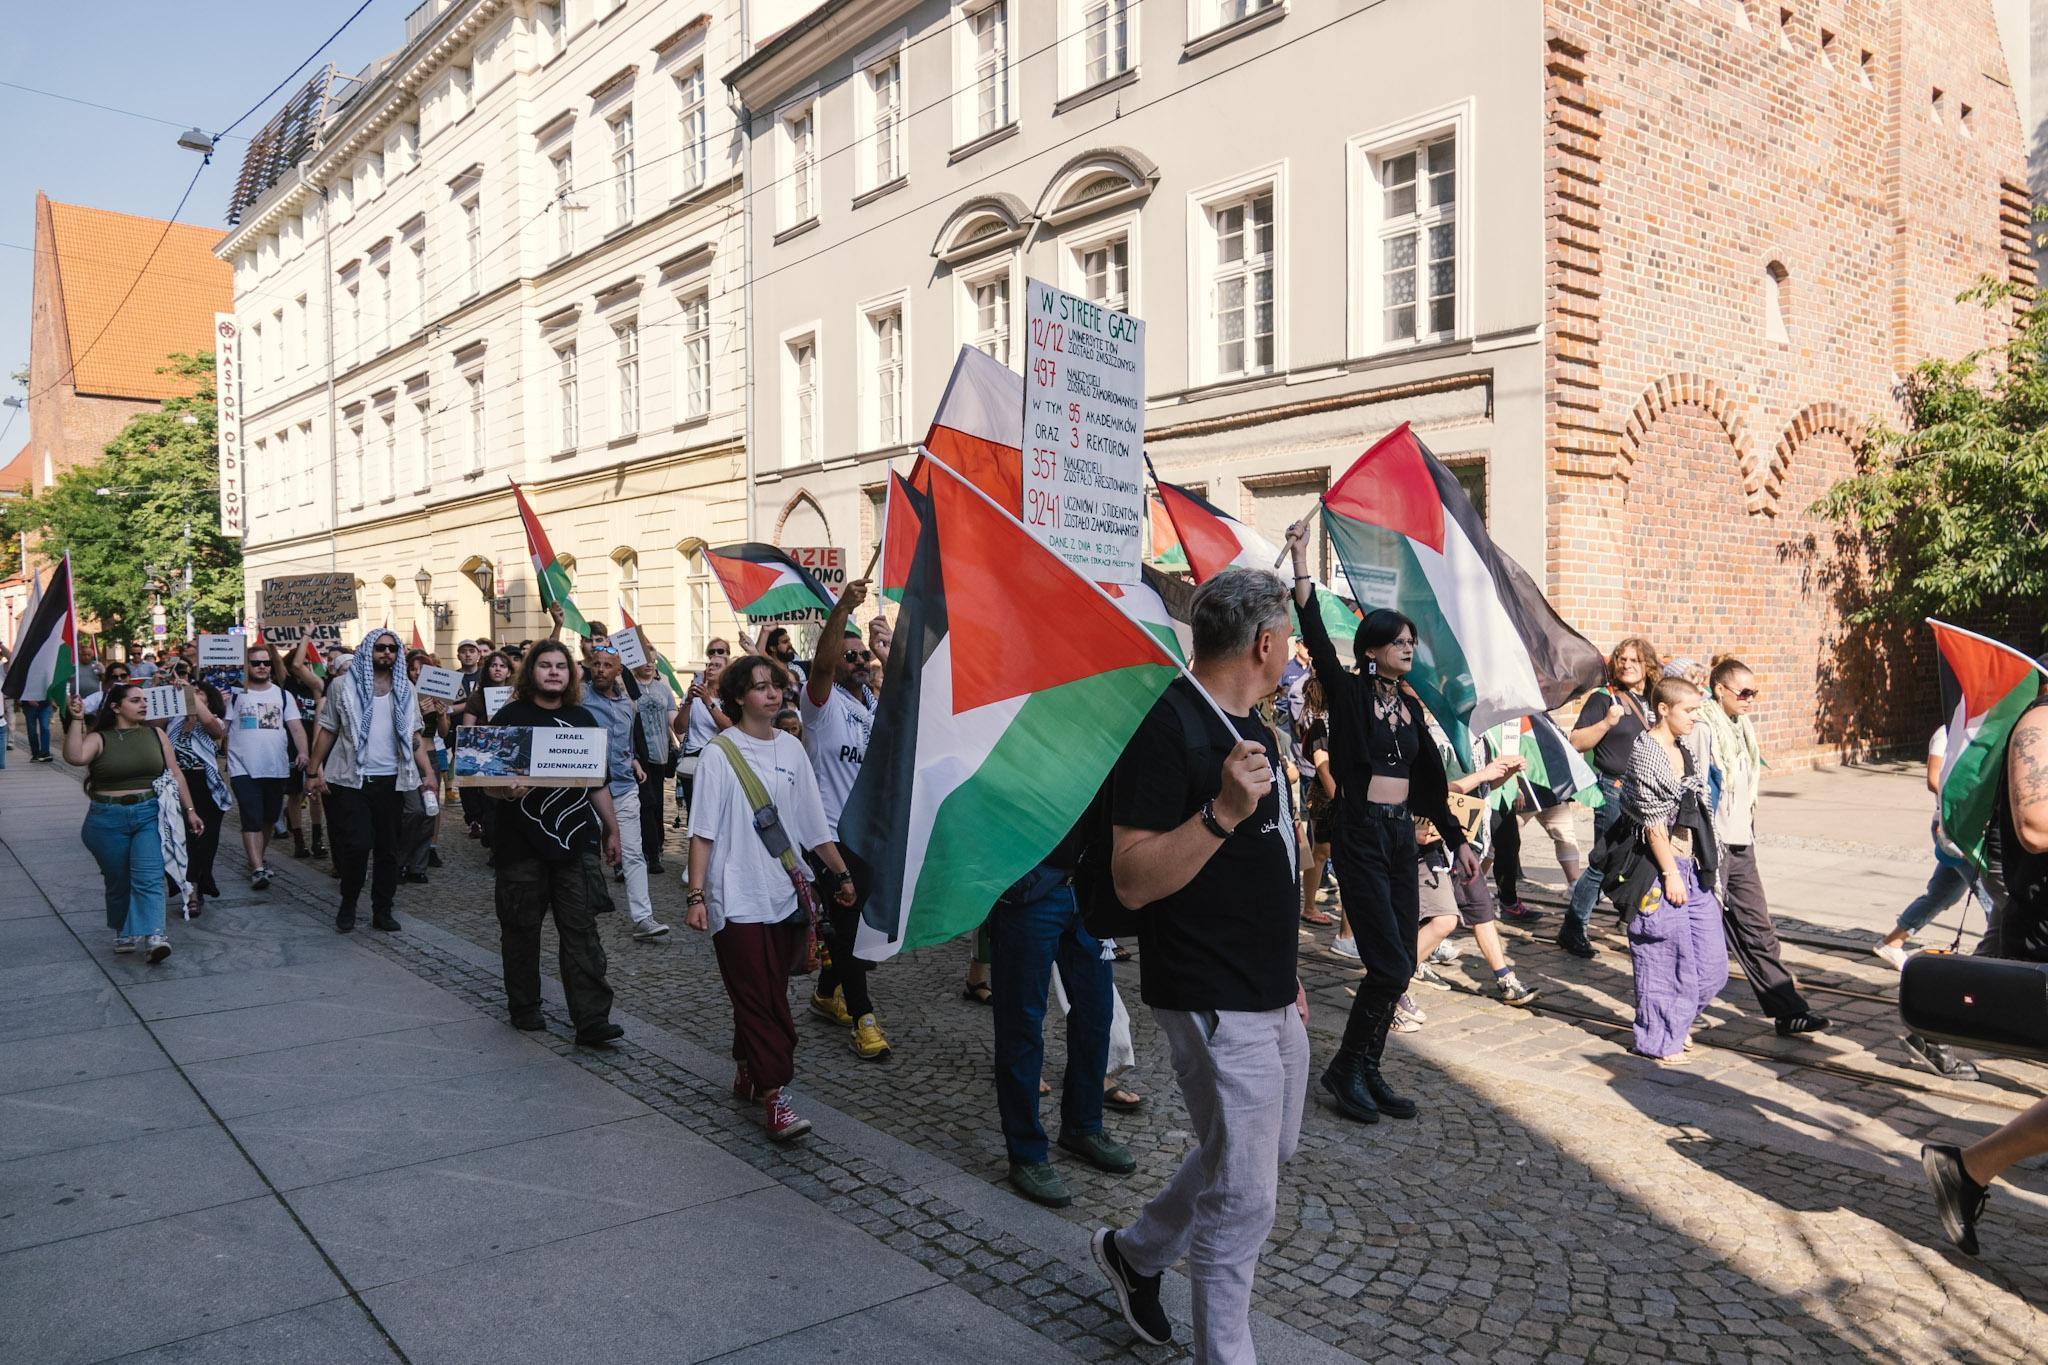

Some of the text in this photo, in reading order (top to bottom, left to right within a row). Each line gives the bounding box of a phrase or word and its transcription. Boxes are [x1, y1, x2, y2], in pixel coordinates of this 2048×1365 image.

[1041, 288, 1138, 344] W STREFIE GAZY
[1032, 317, 1063, 352] 12/12
[1033, 357, 1056, 387] 497
[1033, 399, 1137, 434] W TYM 95 AKADEMIKÓW
[223, 343, 240, 529] HASTON OLD TOWN
[1035, 423, 1060, 441] ORAZ
[1070, 427, 1079, 448] 3
[1031, 448, 1056, 480] 357
[1028, 488, 1060, 529] 9241
[791, 548, 839, 567] AZIE
[1049, 535, 1069, 548] DANE
[1070, 538, 1076, 549] Z
[805, 567, 844, 583] ONO
